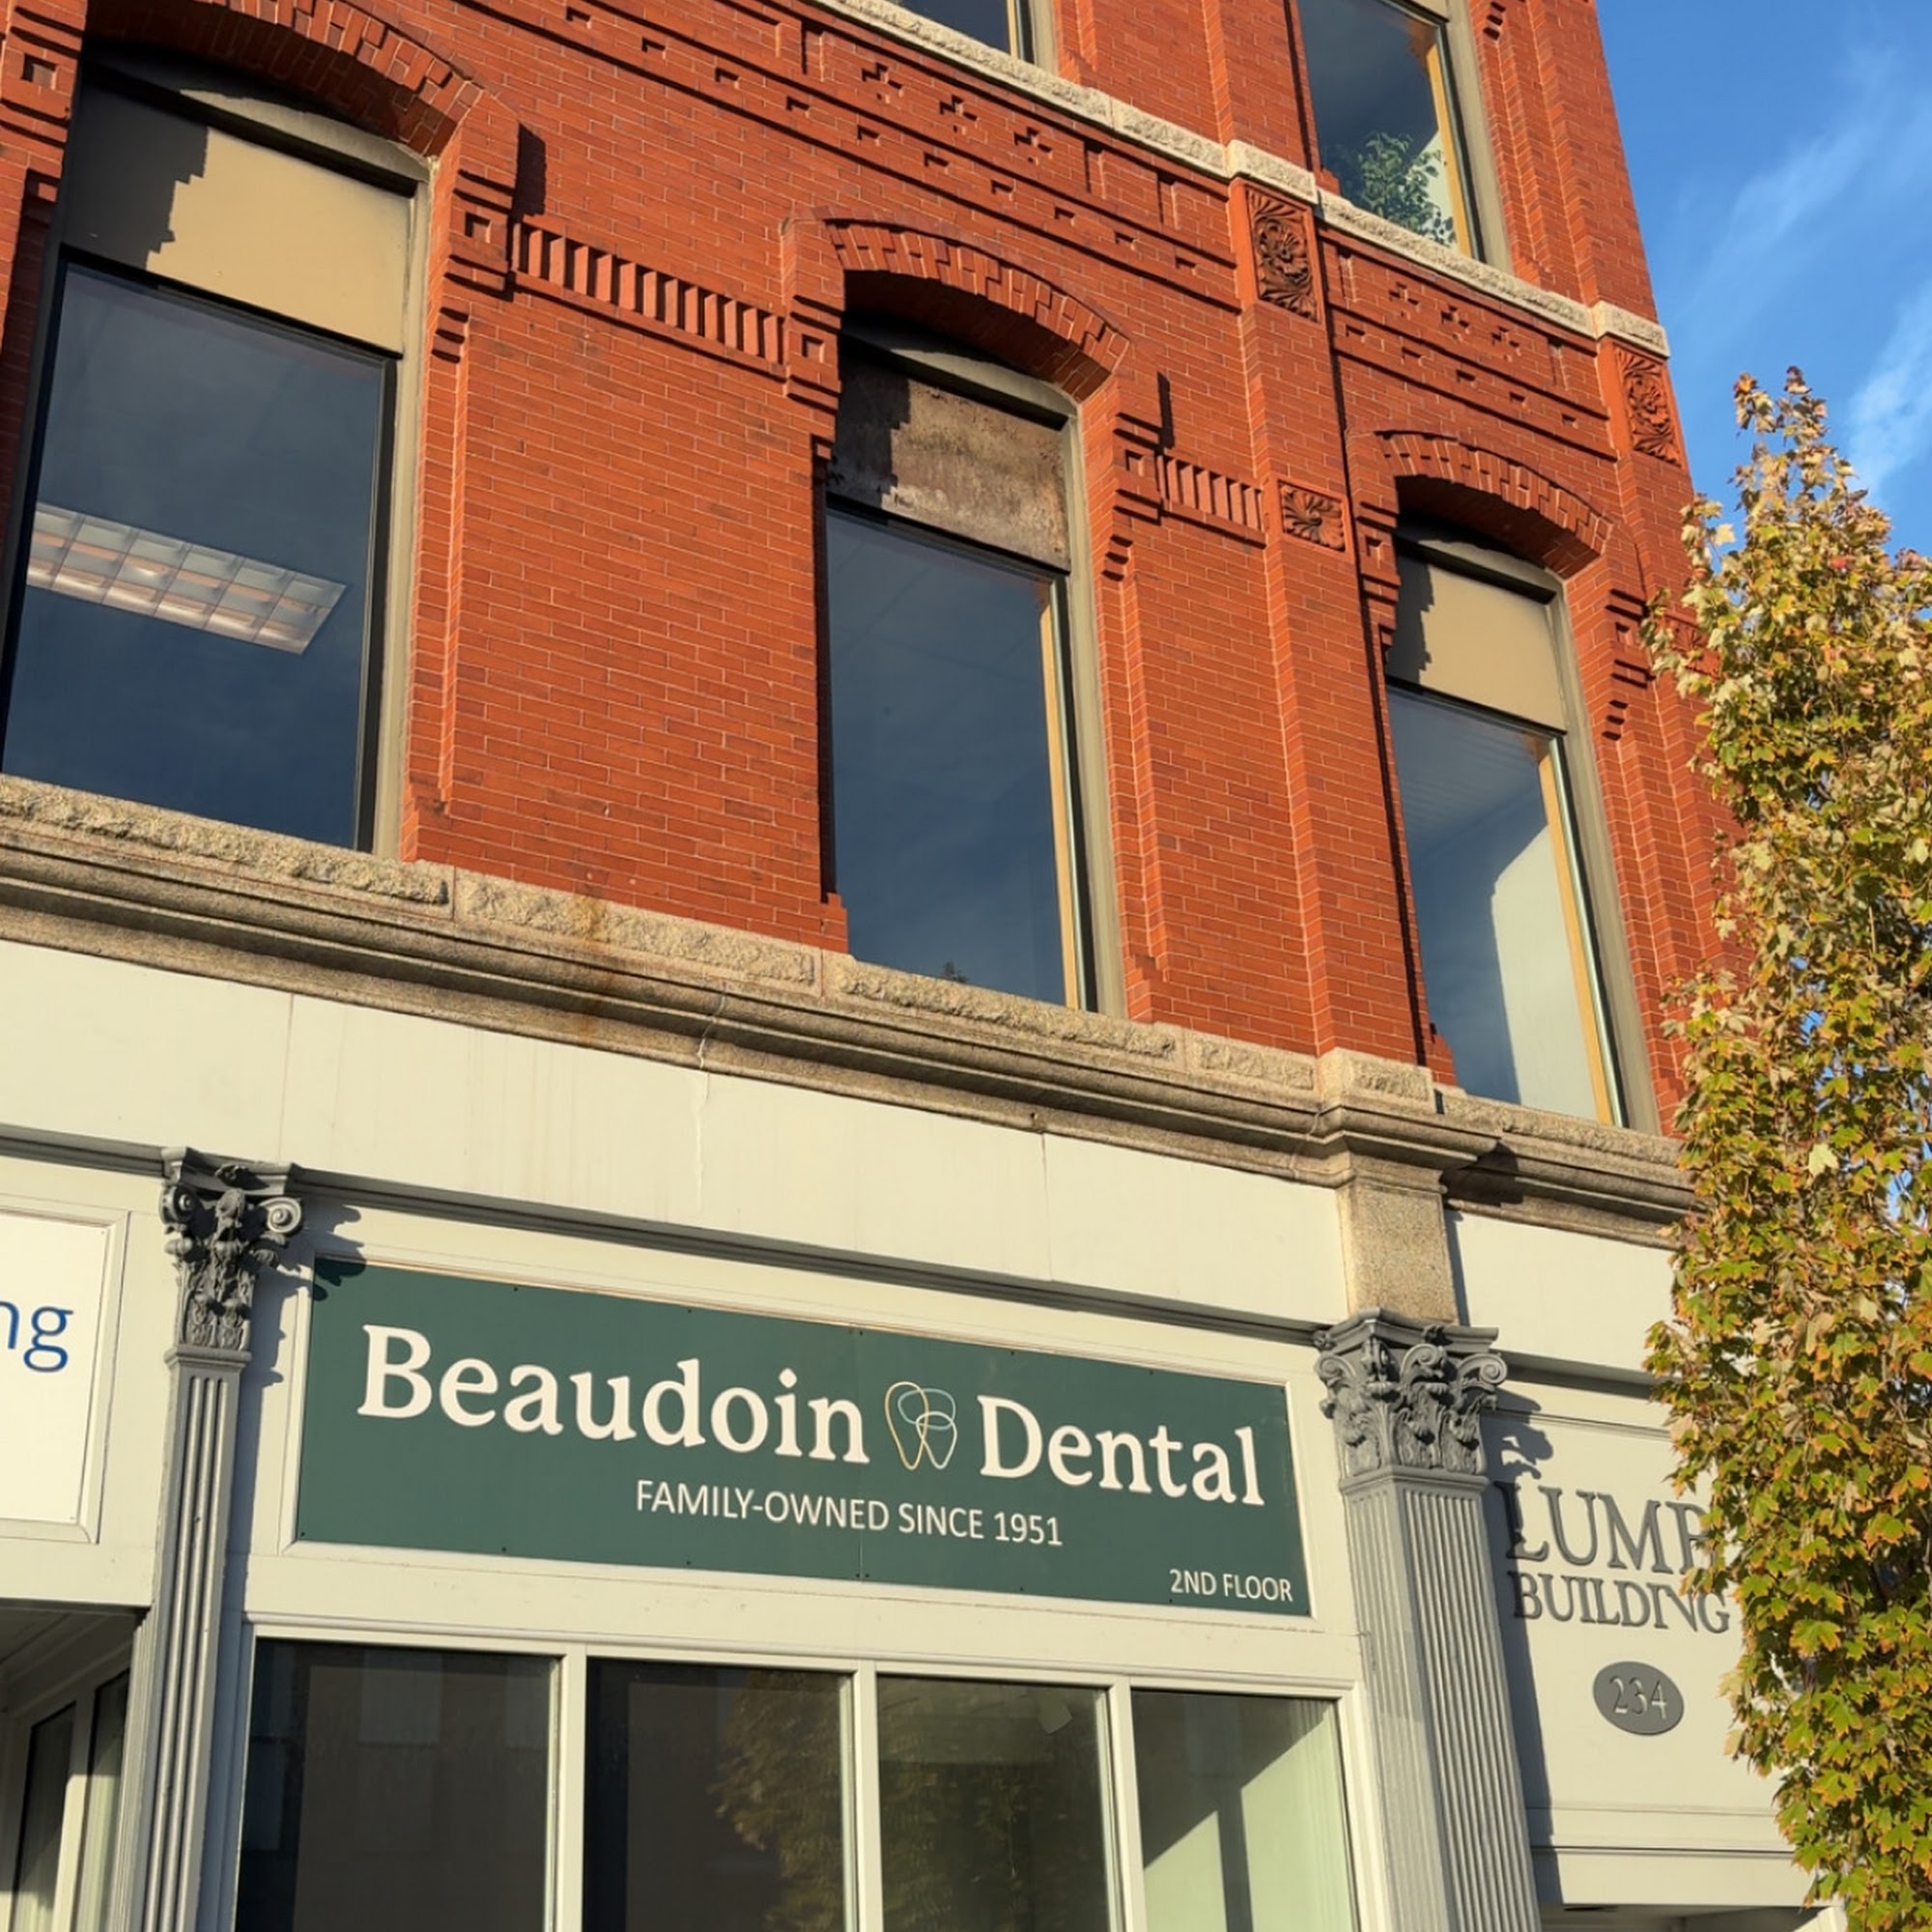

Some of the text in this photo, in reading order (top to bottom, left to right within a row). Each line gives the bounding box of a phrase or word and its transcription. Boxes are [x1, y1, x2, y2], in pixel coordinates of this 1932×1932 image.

[356, 1323, 1265, 1507] Beaudoin Dental
[636, 1478, 1063, 1547] FAMILY-OWNED SINCE 1951
[1169, 1568, 1293, 1603] 2ND FLOOR
[1506, 1570, 1731, 1634] BUILDING
[1608, 1674, 1668, 1721] 234
